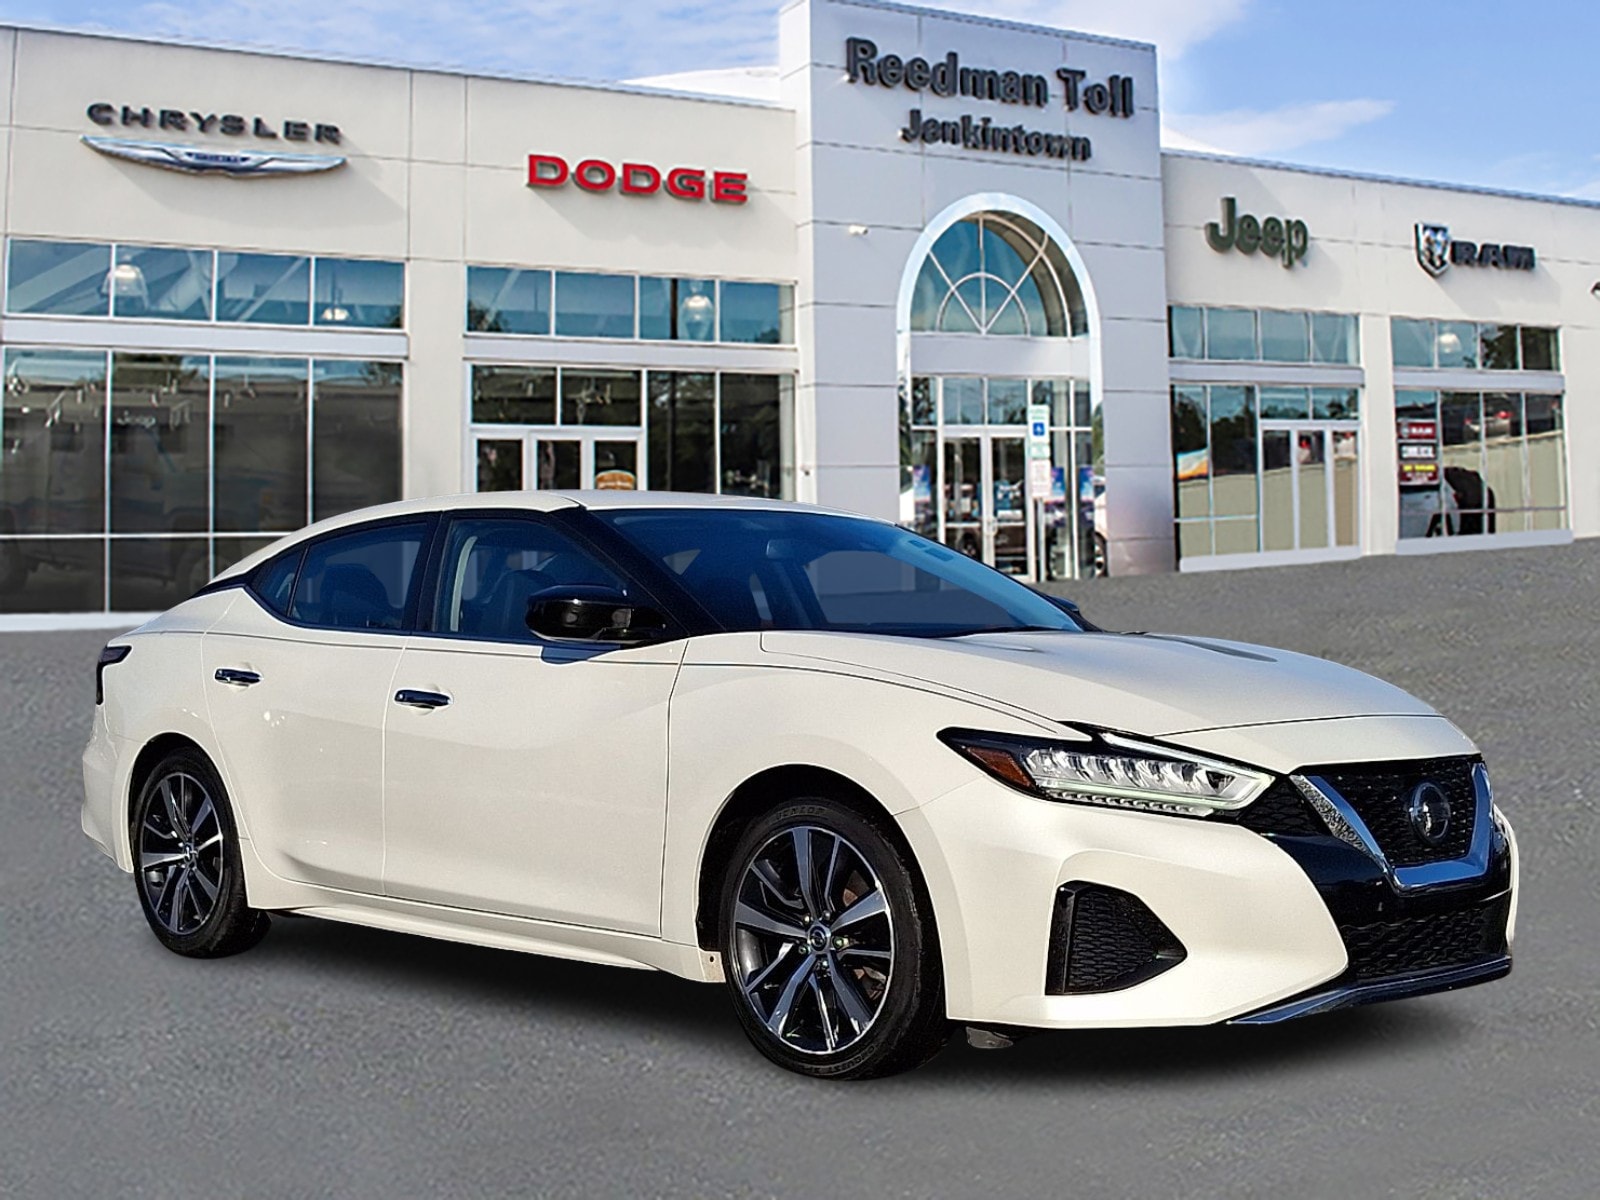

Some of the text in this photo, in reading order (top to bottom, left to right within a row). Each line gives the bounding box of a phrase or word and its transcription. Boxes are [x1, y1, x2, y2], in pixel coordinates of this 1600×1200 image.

[846, 37, 1134, 118] Reedman Toll
[87, 102, 341, 145] CHRYSLER
[901, 109, 1092, 161] Jenkintown
[527, 154, 748, 204] DODGE
[1204, 197, 1308, 269] Jeep
[1451, 241, 1535, 270] RAM
